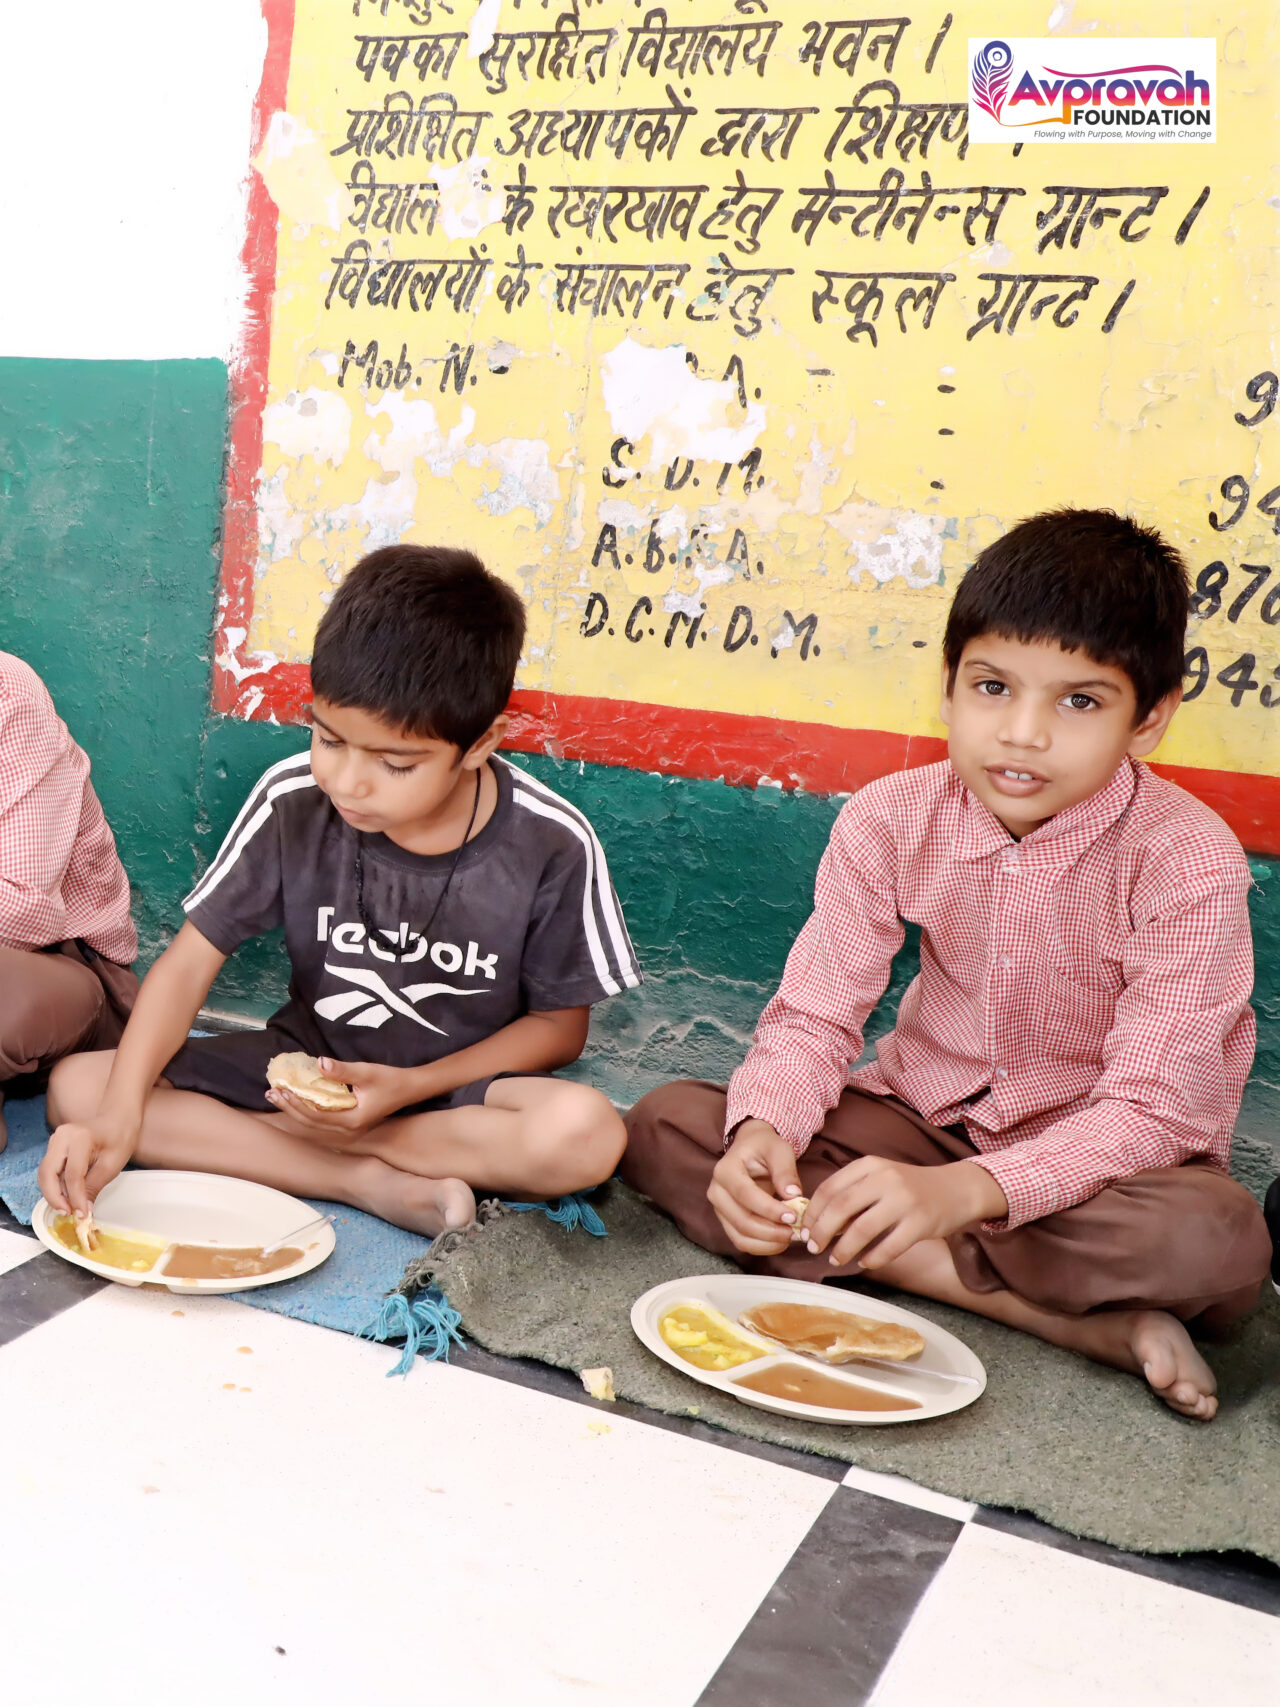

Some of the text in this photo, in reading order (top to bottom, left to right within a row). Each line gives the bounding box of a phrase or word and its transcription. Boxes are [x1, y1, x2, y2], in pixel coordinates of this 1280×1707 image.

[479, 13, 618, 94] सुरक्षित
[620, 8, 784, 79] विद्यालय
[798, 17, 911, 77] भवन
[493, 84, 698, 162] अध्यापकों
[700, 106, 820, 163] द्वारा
[502, 162, 537, 236] के
[699, 169, 784, 255] हेतु
[1035, 186, 1169, 255] ग्रान्ट
[324, 239, 494, 313] विद्यालयों
[496, 244, 543, 314] के
[555, 246, 691, 319] संचालन
[686, 252, 795, 337] हेतु
[812, 270, 957, 348] स्कूल
[966, 273, 1099, 341] ग्रान्ट
[337, 339, 422, 391] Mob.
